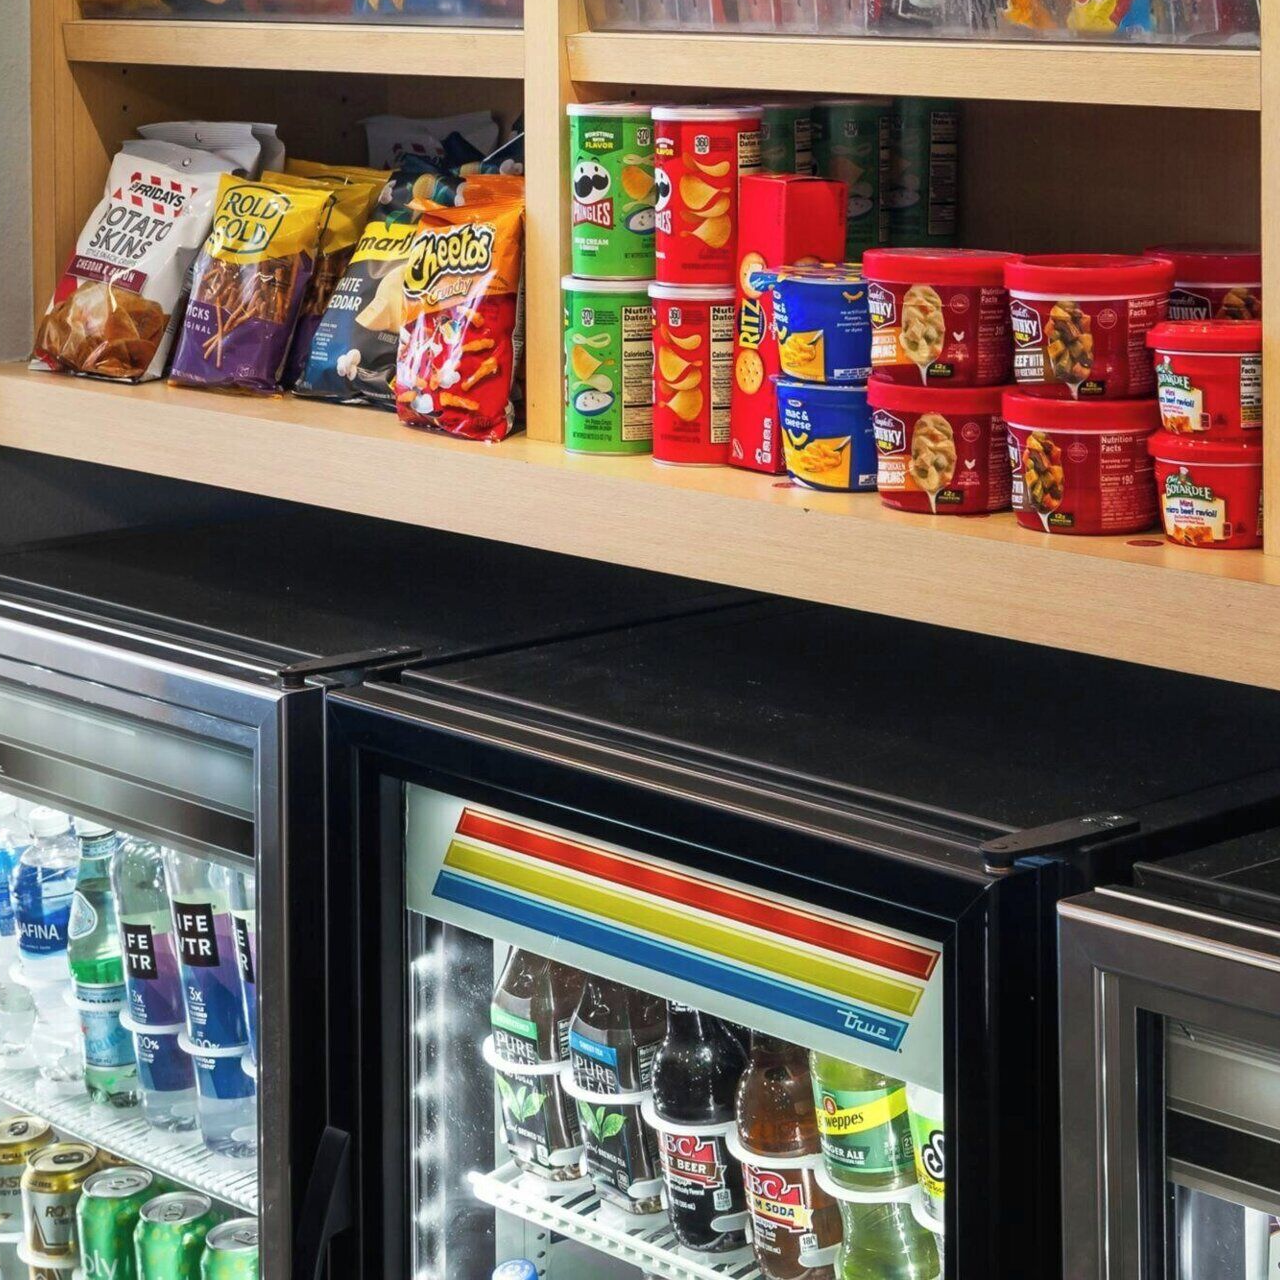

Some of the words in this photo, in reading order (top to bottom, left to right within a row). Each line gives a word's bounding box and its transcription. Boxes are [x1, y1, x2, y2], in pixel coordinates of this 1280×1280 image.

[584, 141, 614, 150] FLAVOR
[134, 183, 186, 208] FRIDAYS
[223, 191, 278, 222] ROLD
[215, 214, 267, 245] GOLD
[89, 224, 153, 260] SKINS
[404, 224, 492, 292] Cheetos
[428, 277, 473, 304] Crunchy
[738, 298, 761, 351] RITZ
[784, 417, 812, 431] cheese
[1101, 434, 1133, 445] Nutrition
[1101, 444, 1122, 453] Facts
[1165, 483, 1213, 502] BOYARDEE
[176, 913, 210, 933] IFE
[188, 986, 204, 1002] 3x
[836, 1009, 890, 1041] true
[495, 1030, 536, 1061] PURE
[574, 1053, 617, 1088] PURE
[824, 1111, 865, 1131] weppes
[846, 1148, 866, 1161] ALE
[677, 1159, 708, 1175] BEER
[765, 1202, 796, 1219] SODA
